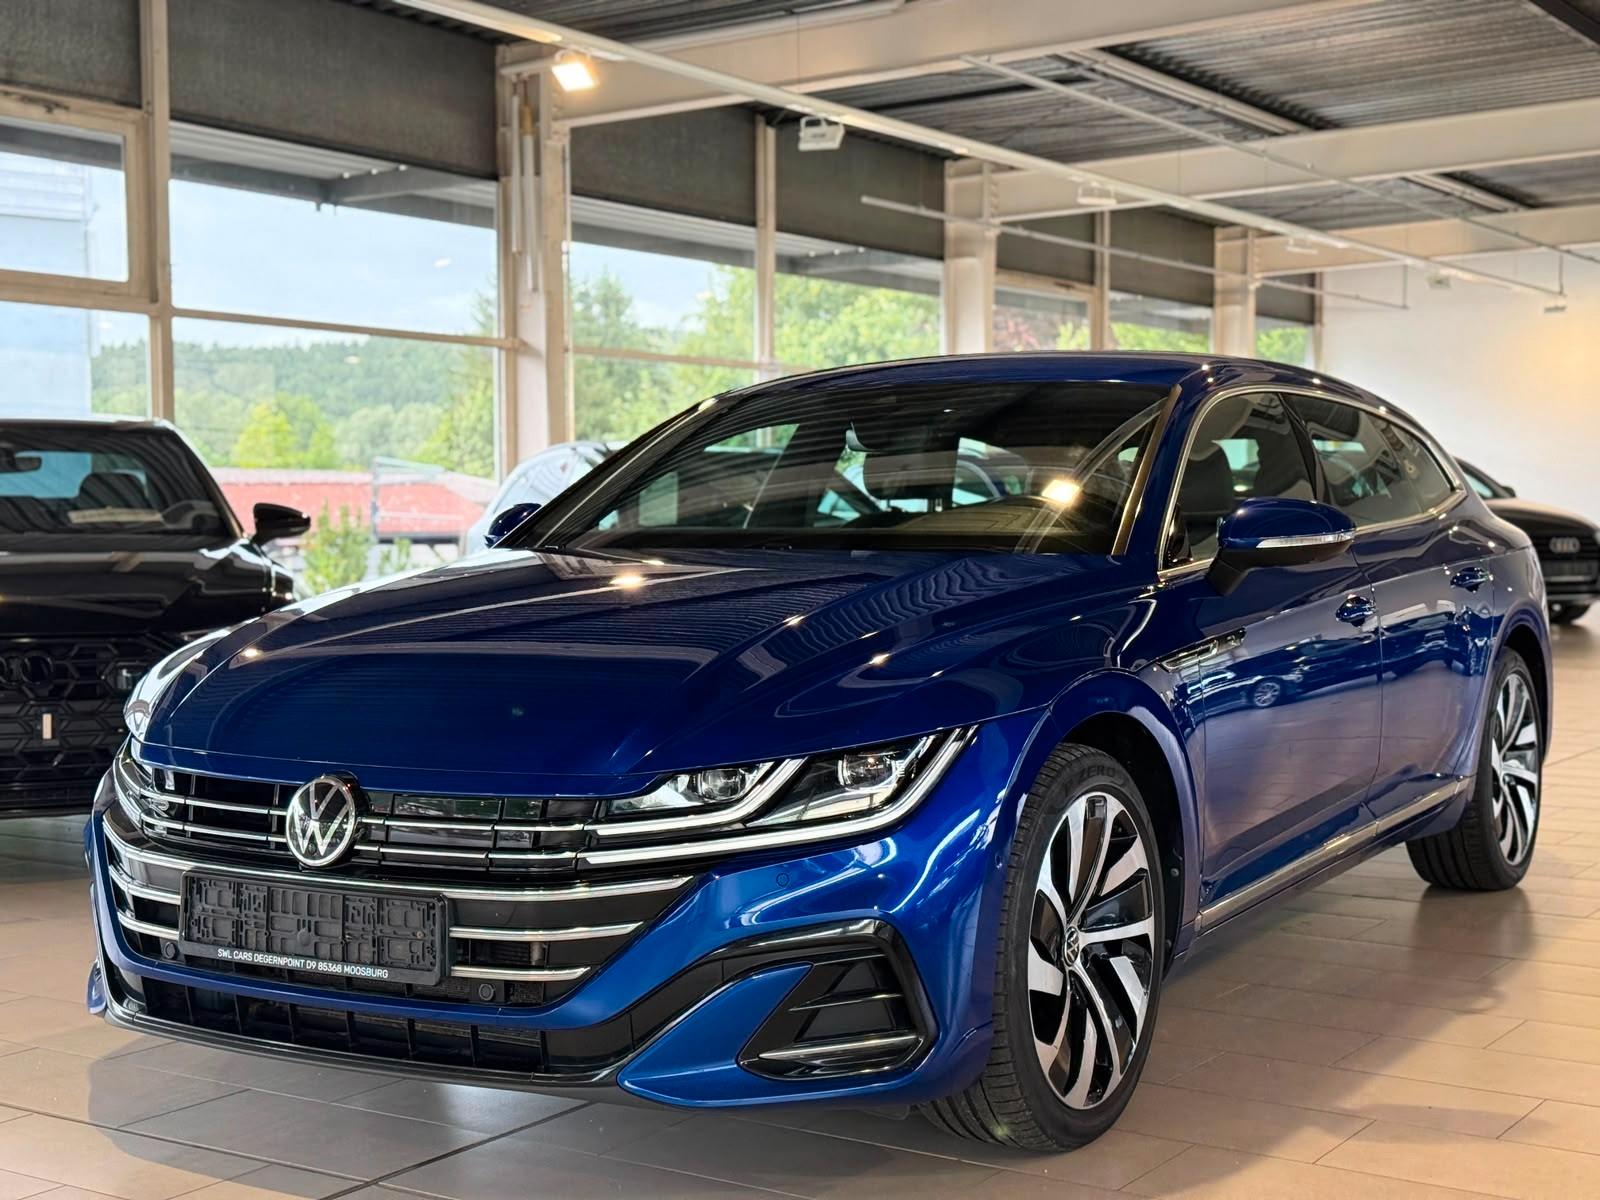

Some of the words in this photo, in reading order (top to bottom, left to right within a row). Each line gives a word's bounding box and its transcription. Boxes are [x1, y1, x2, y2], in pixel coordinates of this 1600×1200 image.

[217, 947, 232, 959] SWL
[233, 950, 253, 962] CARS
[254, 953, 305, 968] DEGERNPOINT
[318, 961, 342, 973] 85368
[344, 965, 389, 979] MOOSBURG
